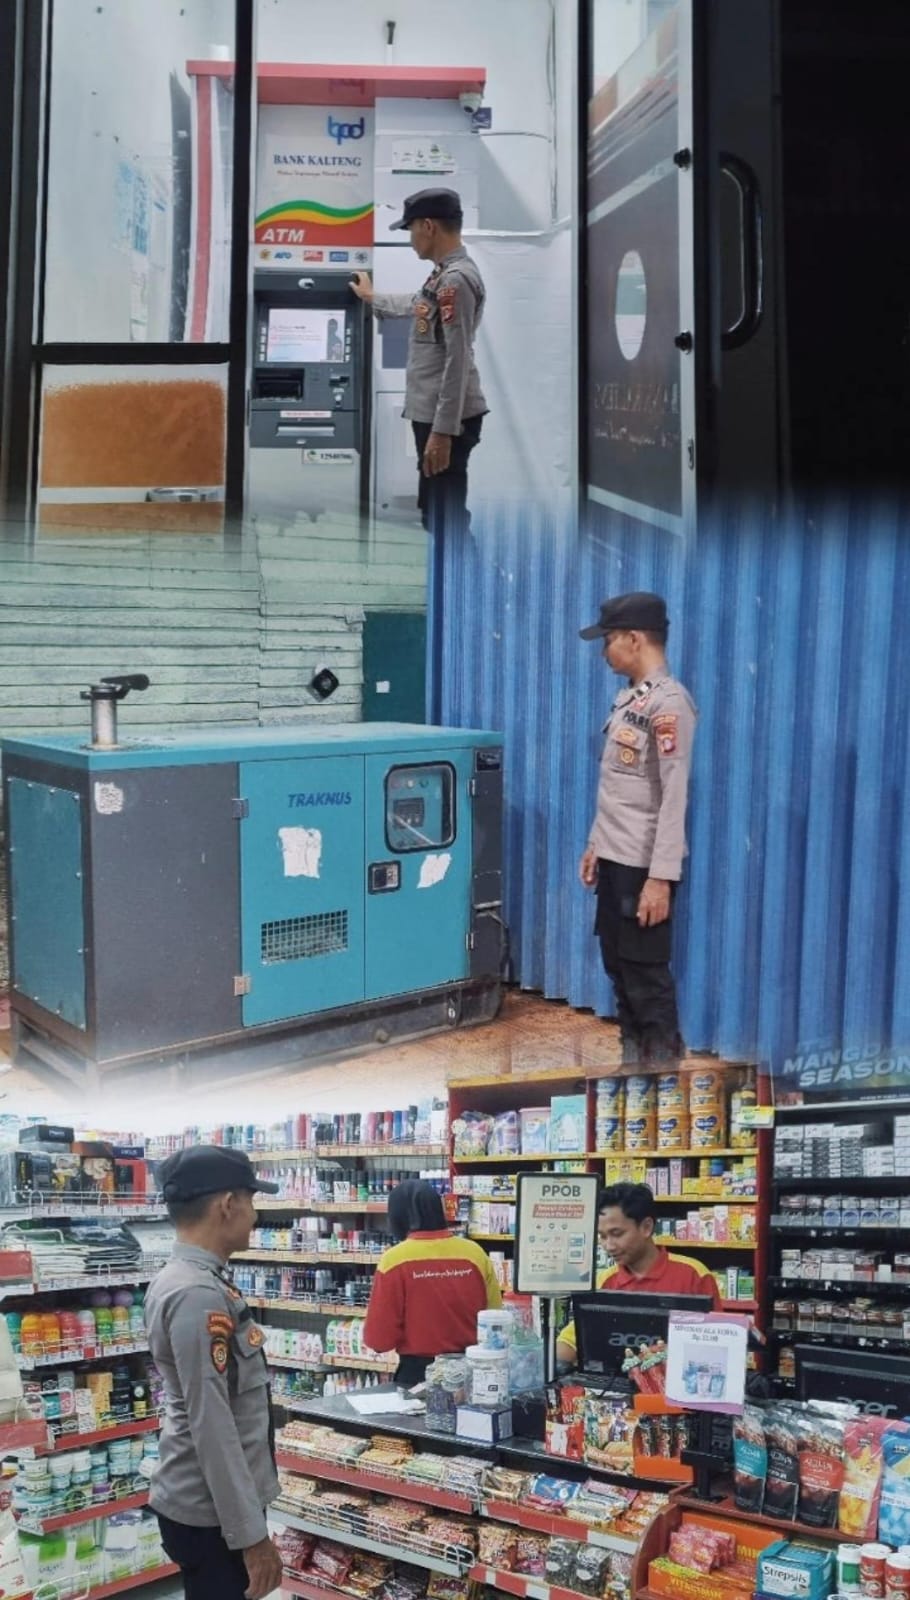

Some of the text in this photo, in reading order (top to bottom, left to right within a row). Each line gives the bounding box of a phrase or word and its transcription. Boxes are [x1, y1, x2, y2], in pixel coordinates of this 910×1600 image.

[274, 154, 362, 167] BANK KALTENG
[261, 228, 305, 243] ATM
[288, 791, 352, 808] TRAKNUS
[542, 1184, 582, 1198] PPOB
[763, 1565, 808, 1584] Strepsils
